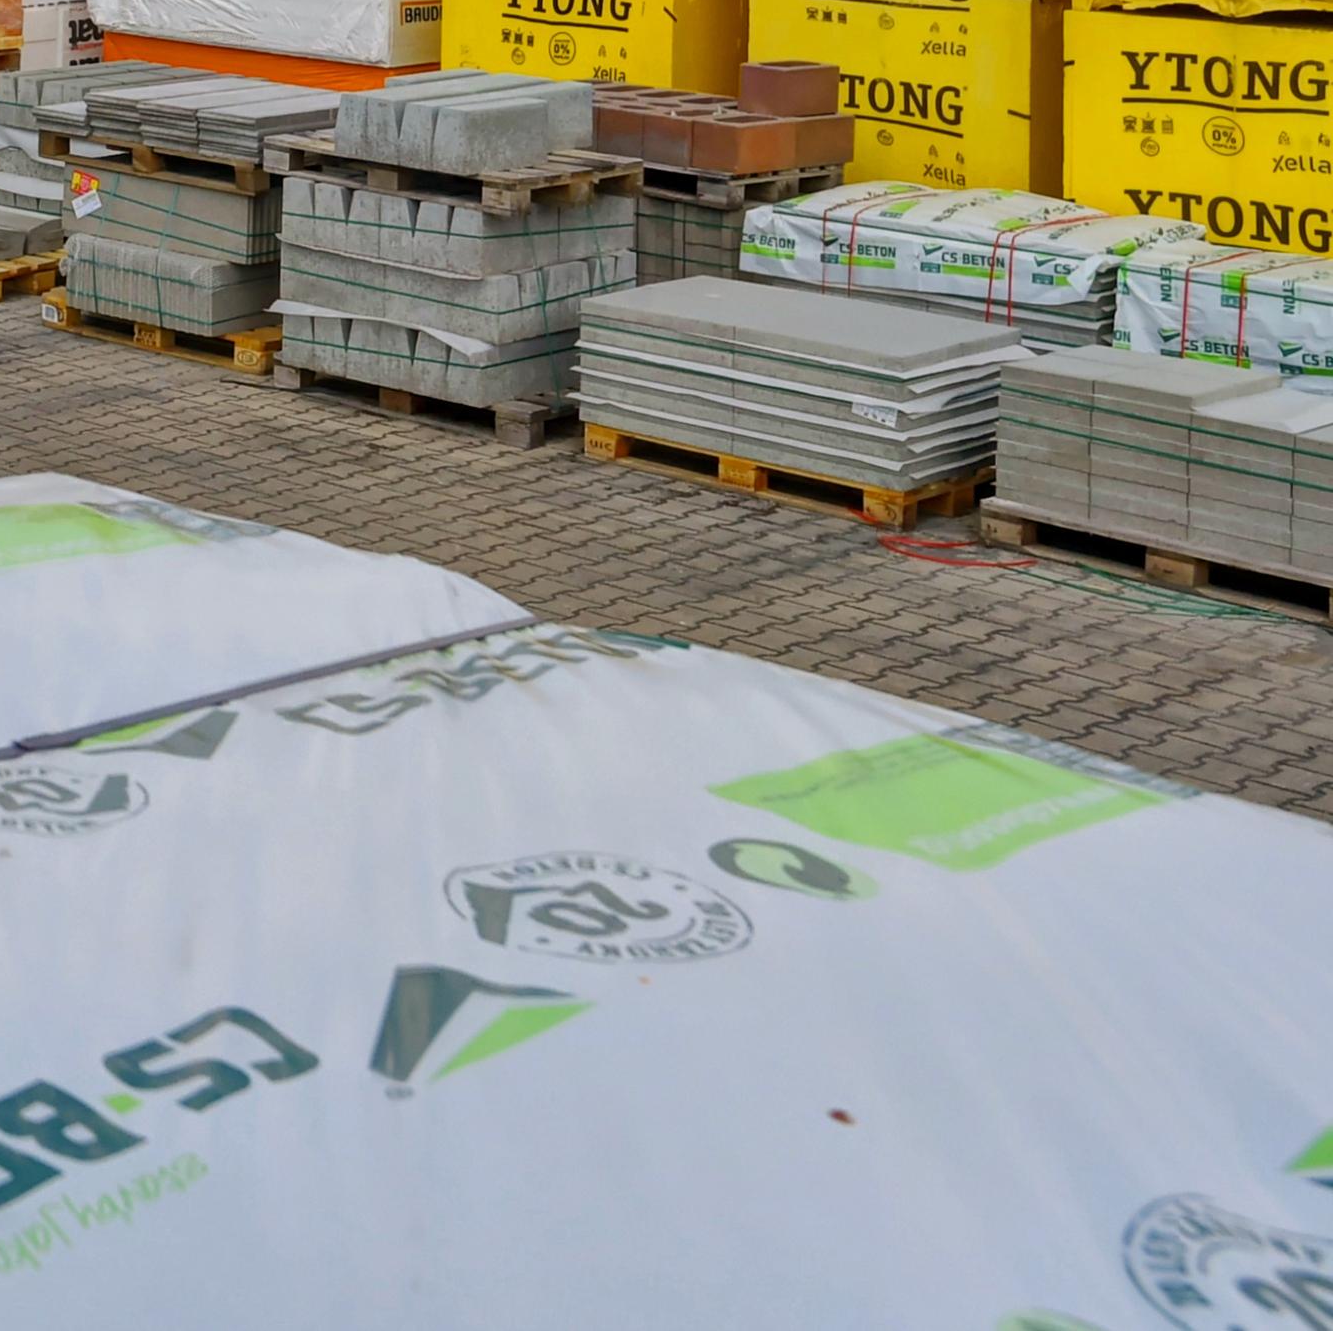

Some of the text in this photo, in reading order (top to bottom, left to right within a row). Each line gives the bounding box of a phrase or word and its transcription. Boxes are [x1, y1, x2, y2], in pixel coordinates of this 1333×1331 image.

[404, 4, 444, 23] BAUD
[553, 43, 570, 55] 0%
[920, 40, 967, 57] Xella
[593, 66, 626, 82] Xella
[1121, 50, 1329, 103] YTONG
[839, 73, 964, 126] TONG
[1212, 128, 1237, 145] 0%
[923, 163, 966, 187] Xella
[1272, 155, 1332, 175] Xella
[1124, 189, 1333, 254] YTONG
[528, 880, 671, 936] 20
